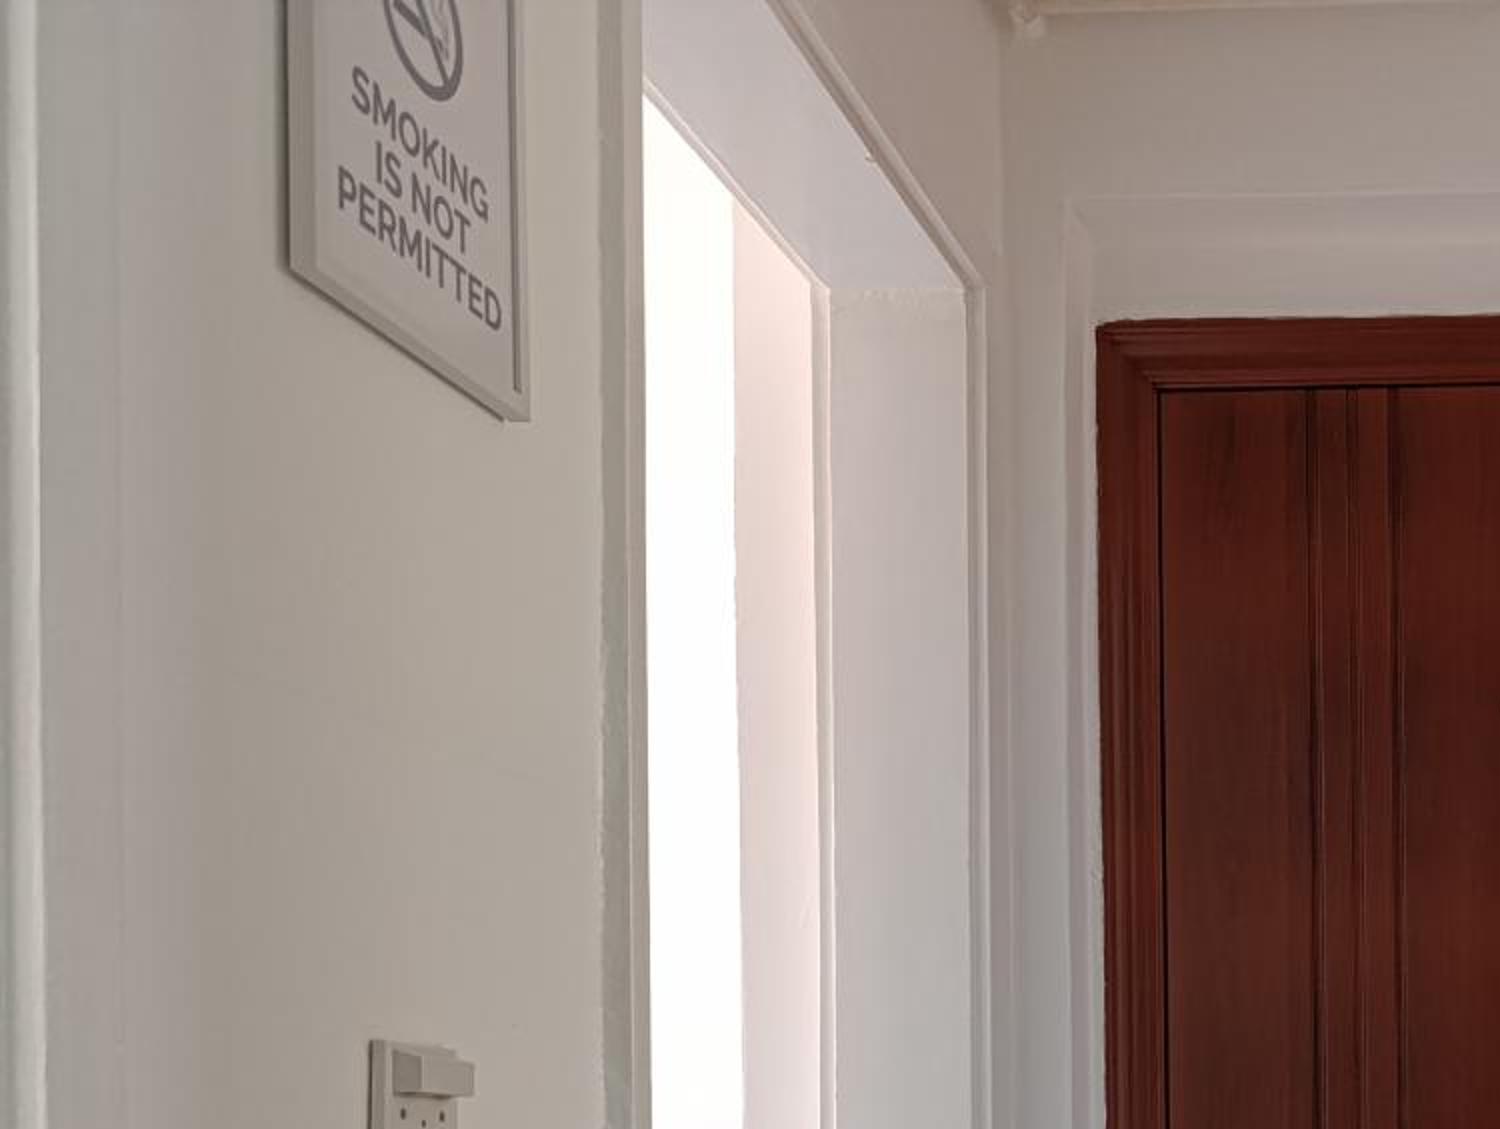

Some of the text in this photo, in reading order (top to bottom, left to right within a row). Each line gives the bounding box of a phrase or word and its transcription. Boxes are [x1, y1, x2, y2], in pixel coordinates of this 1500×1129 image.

[352, 65, 488, 223] SMOKING
[376, 140, 470, 254] IS NOT
[338, 165, 502, 331] PERMITTED
